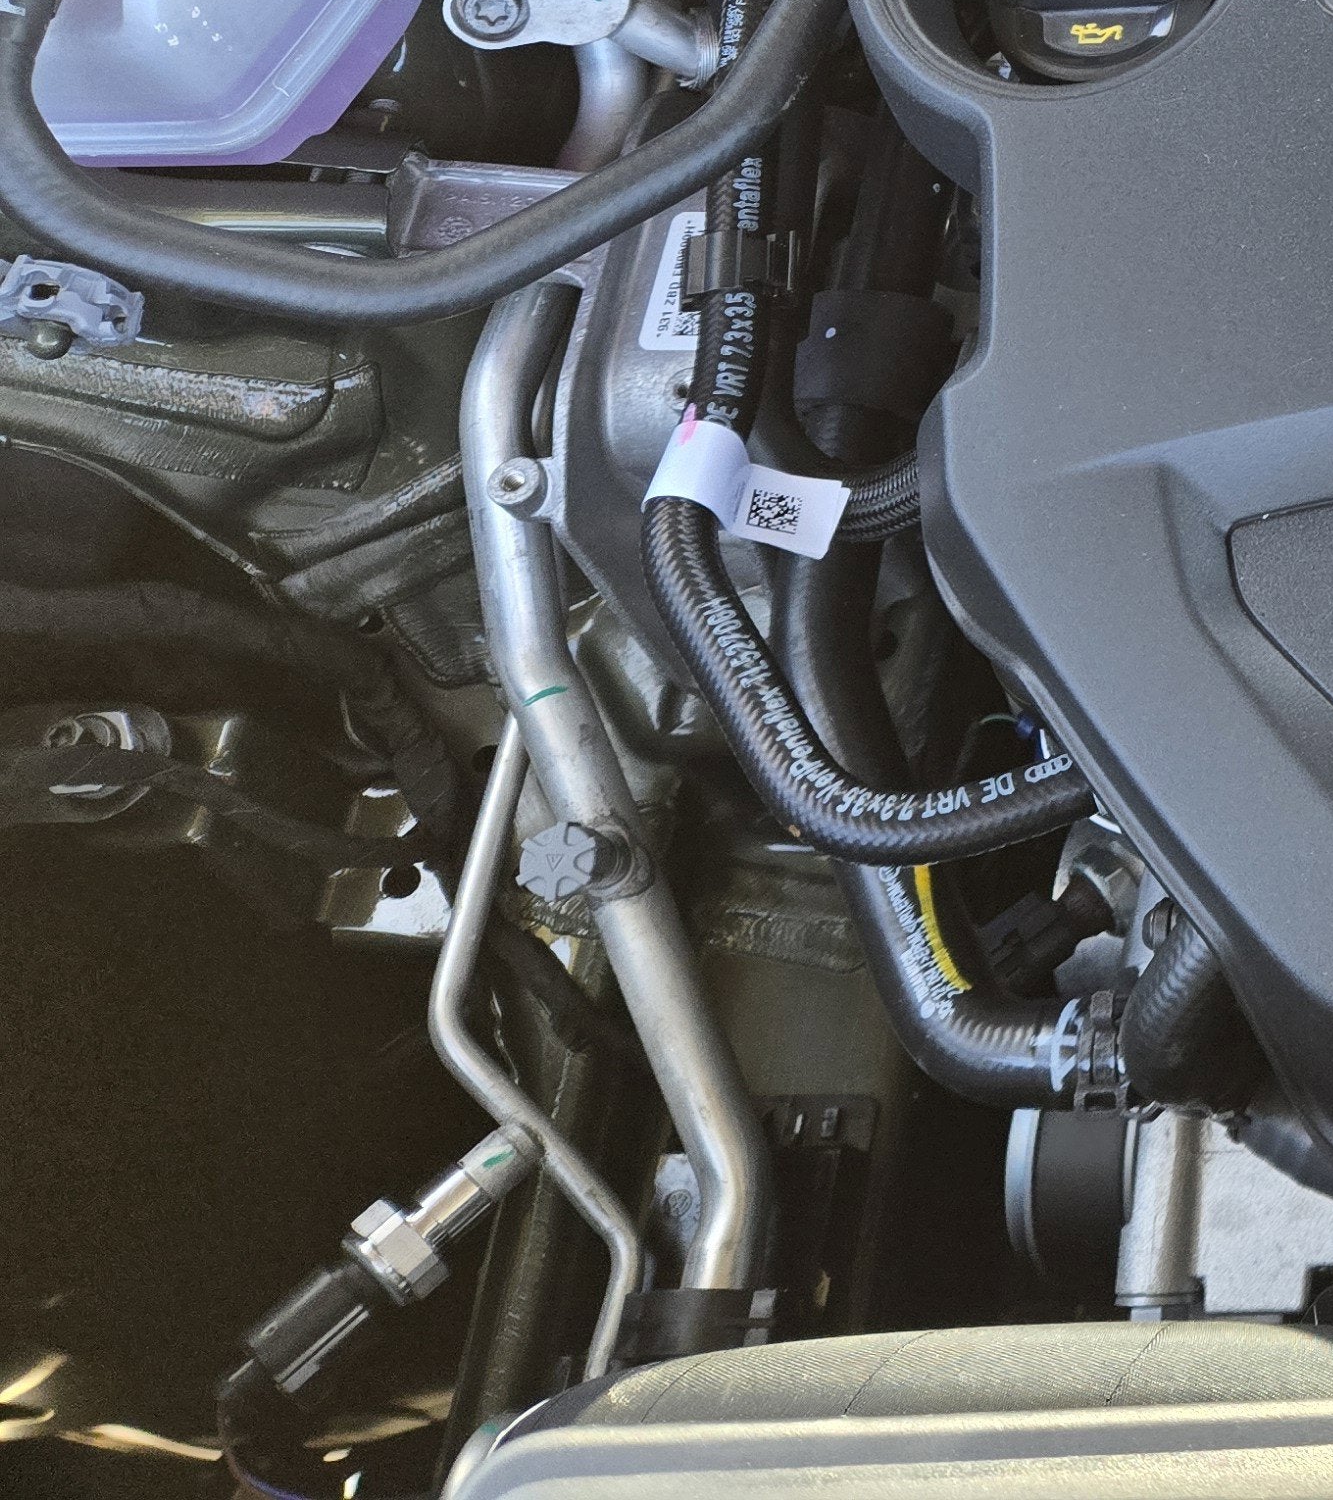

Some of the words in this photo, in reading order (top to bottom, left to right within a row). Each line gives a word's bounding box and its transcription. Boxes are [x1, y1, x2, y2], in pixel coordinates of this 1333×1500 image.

[713, 361, 750, 398] VRT
[920, 786, 973, 820] VRT
[978, 771, 1017, 805] DE
